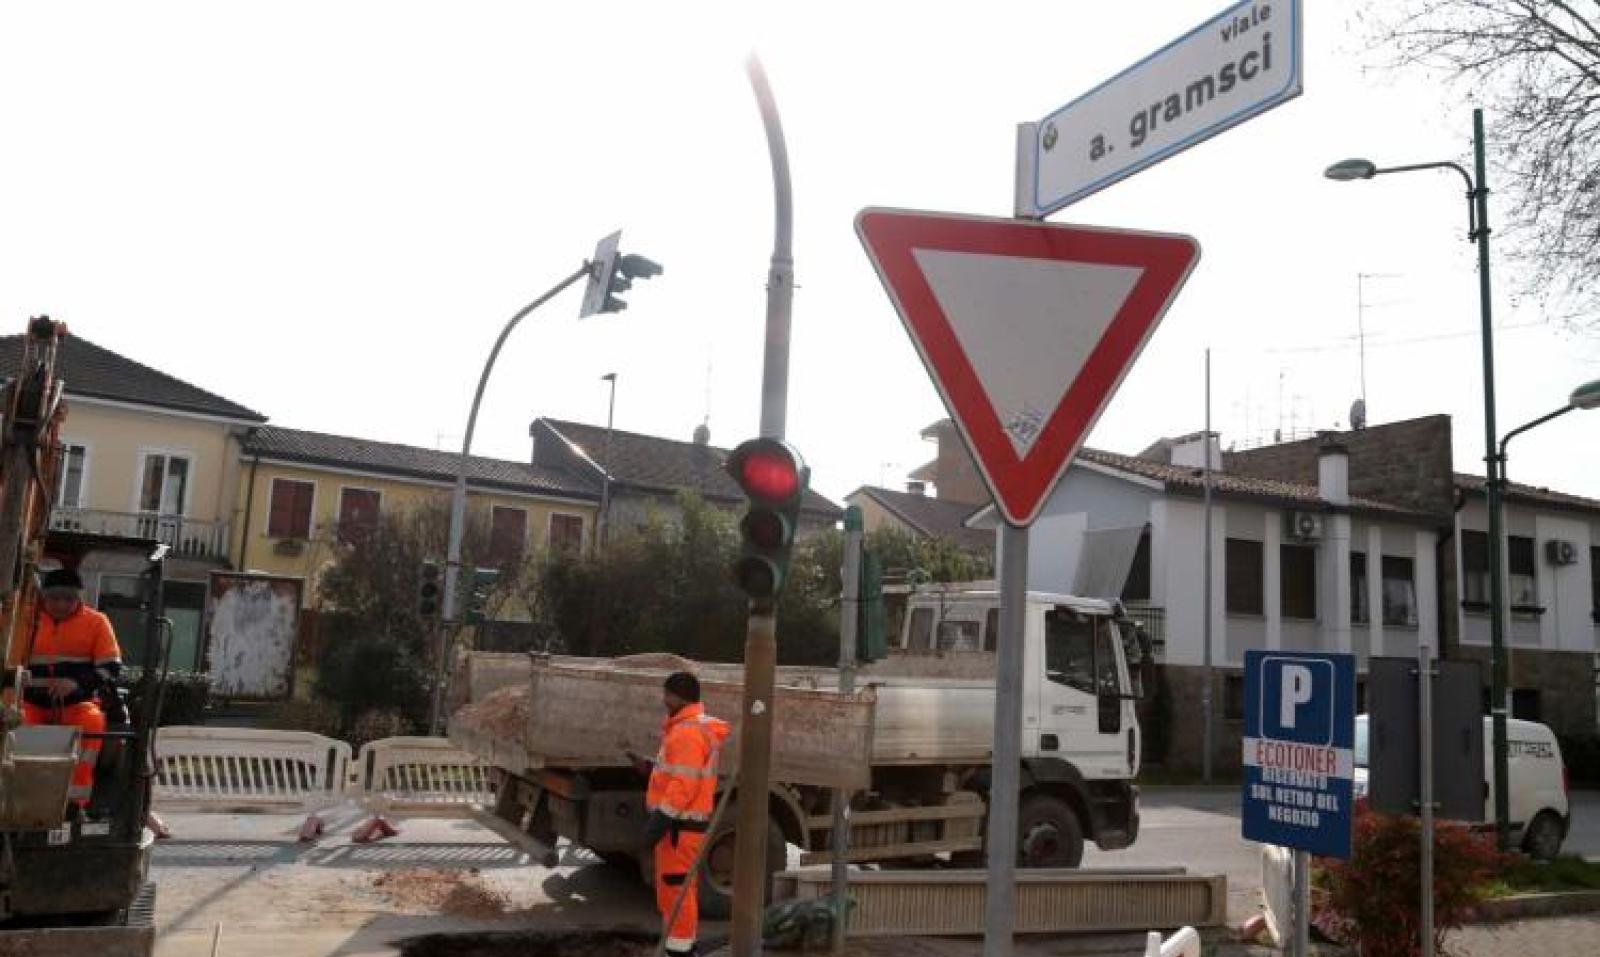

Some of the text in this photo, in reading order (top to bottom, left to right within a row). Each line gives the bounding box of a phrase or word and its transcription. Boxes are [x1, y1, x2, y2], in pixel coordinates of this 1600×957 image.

[1220, 4, 1271, 42] viale
[1089, 32, 1272, 161] a. gramsci
[1280, 664, 1312, 728] P
[1256, 743, 1337, 776] ECOTONER
[1269, 806, 1320, 827] NEGOZIO
